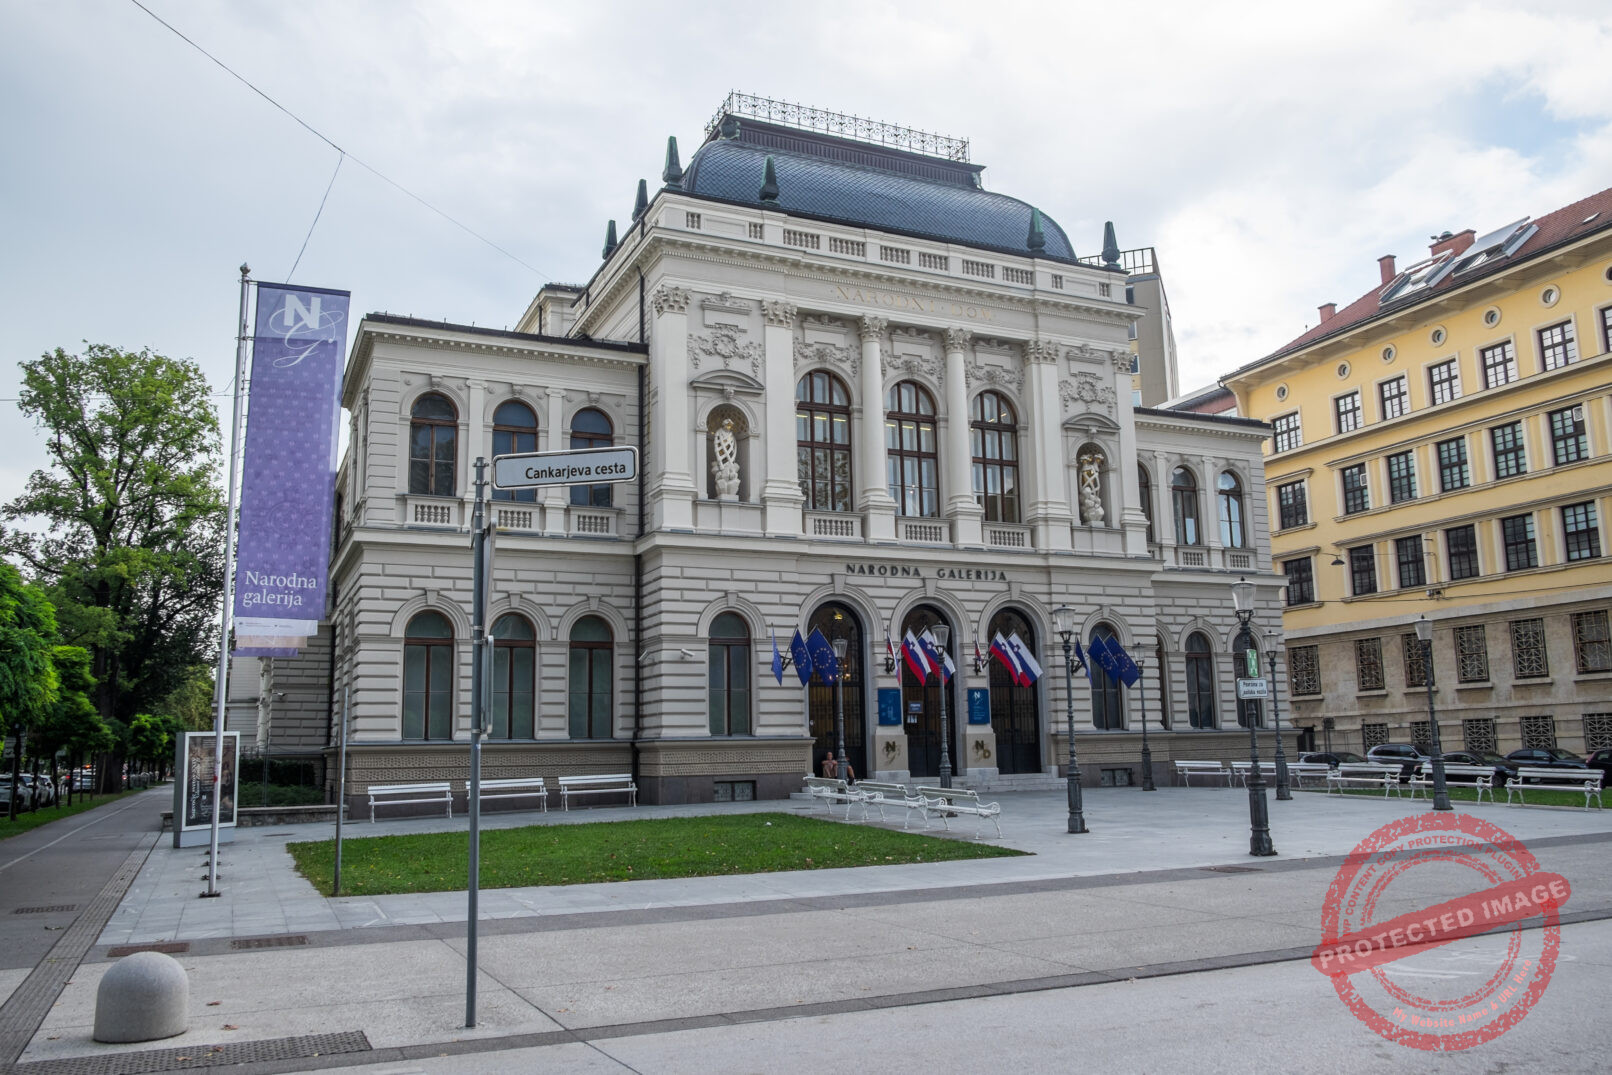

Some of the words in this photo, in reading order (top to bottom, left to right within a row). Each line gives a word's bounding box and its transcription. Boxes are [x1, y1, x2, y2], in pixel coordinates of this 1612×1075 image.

[525, 465, 591, 479] Cankarjeva
[595, 462, 626, 475] cesta
[245, 571, 317, 589] Narodna
[846, 563, 921, 577] NARODNA
[937, 568, 1007, 581] GALERIJA
[242, 589, 303, 608] galerija
